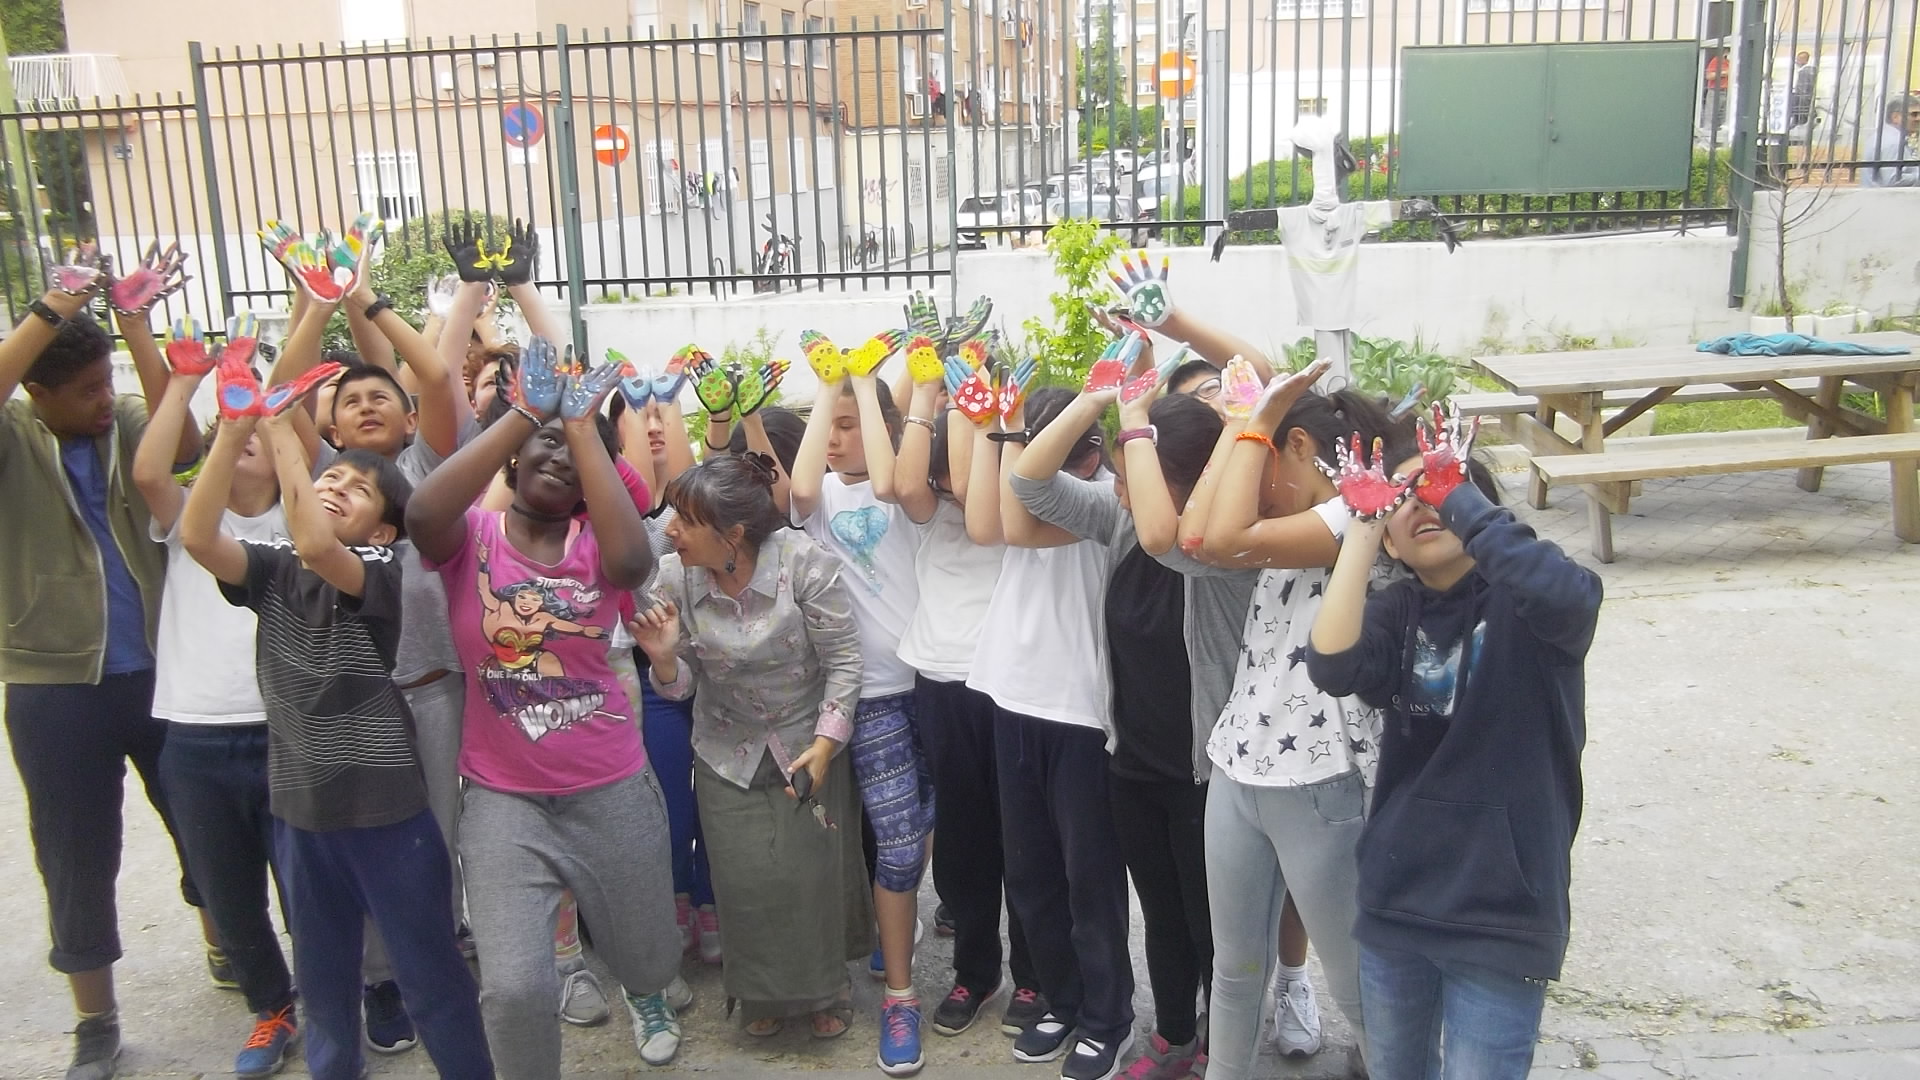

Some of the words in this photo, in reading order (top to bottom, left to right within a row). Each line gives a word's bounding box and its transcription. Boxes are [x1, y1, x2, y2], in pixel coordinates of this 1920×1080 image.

[536, 576, 586, 591] STRENGTH
[486, 666, 505, 679] ONE
[521, 671, 544, 682] ONLY
[1391, 694, 1430, 713] OANS
[518, 693, 604, 742] WOMAN
